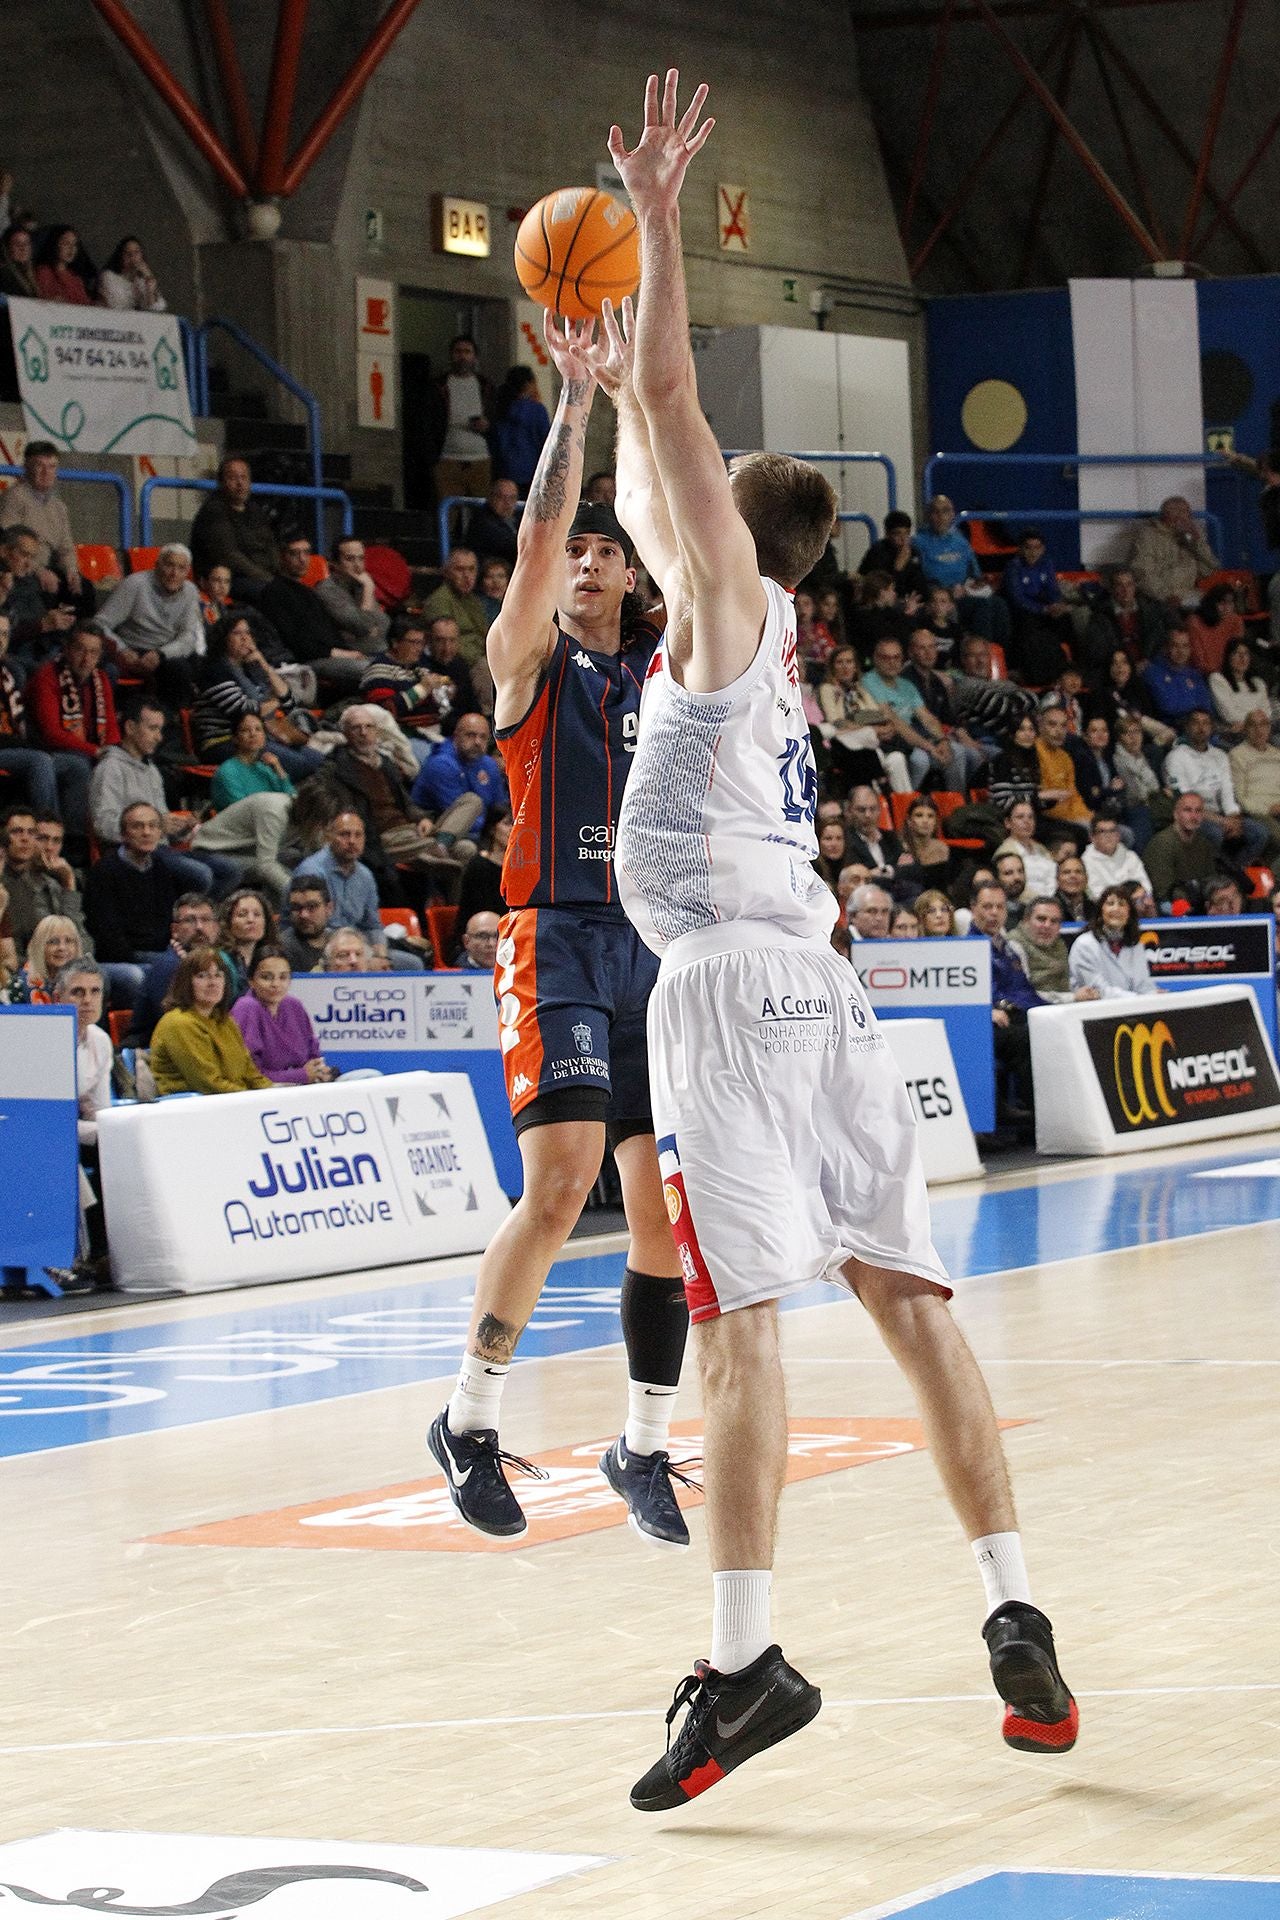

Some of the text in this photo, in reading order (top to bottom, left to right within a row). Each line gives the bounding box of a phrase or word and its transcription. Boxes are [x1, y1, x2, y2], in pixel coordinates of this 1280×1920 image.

[449, 210, 488, 244] BAR
[1144, 945, 1237, 963] NORSOL
[333, 986, 407, 1003] Grupo
[314, 1003, 468, 1023] Julian GRANDE
[762, 997, 776, 1017] A
[759, 1024, 796, 1040] UNHA
[764, 1040, 790, 1054] POR
[553, 1069, 569, 1080] DE
[1167, 1046, 1257, 1091] NORSOL
[260, 1110, 367, 1145] Grupo
[407, 1143, 462, 1176] GRANDE
[248, 1146, 382, 1198] Julian
[223, 1199, 393, 1244] Automotive
